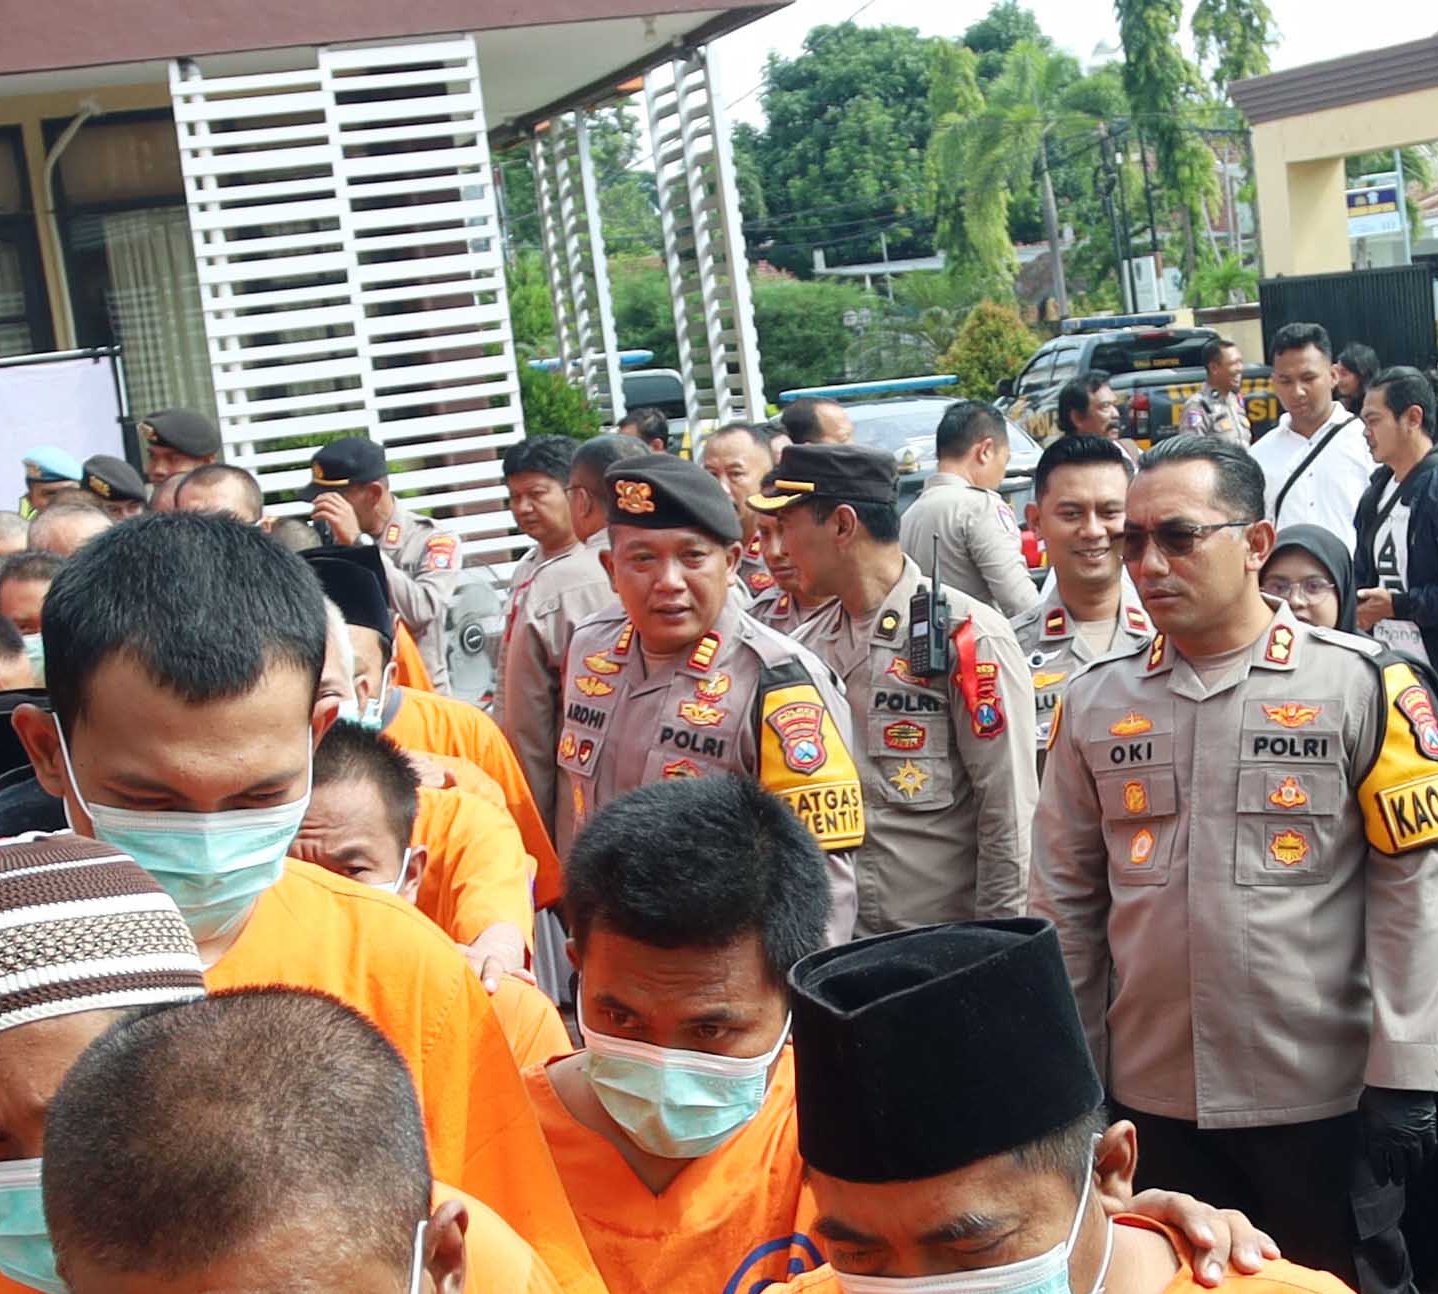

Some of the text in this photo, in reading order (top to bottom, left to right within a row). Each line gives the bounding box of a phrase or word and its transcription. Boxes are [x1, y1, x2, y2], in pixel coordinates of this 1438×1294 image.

[660, 725, 724, 758] POLRI
[1110, 742, 1153, 764] OKI
[1253, 736, 1328, 758] POLRI
[783, 788, 860, 815] ATGAS
